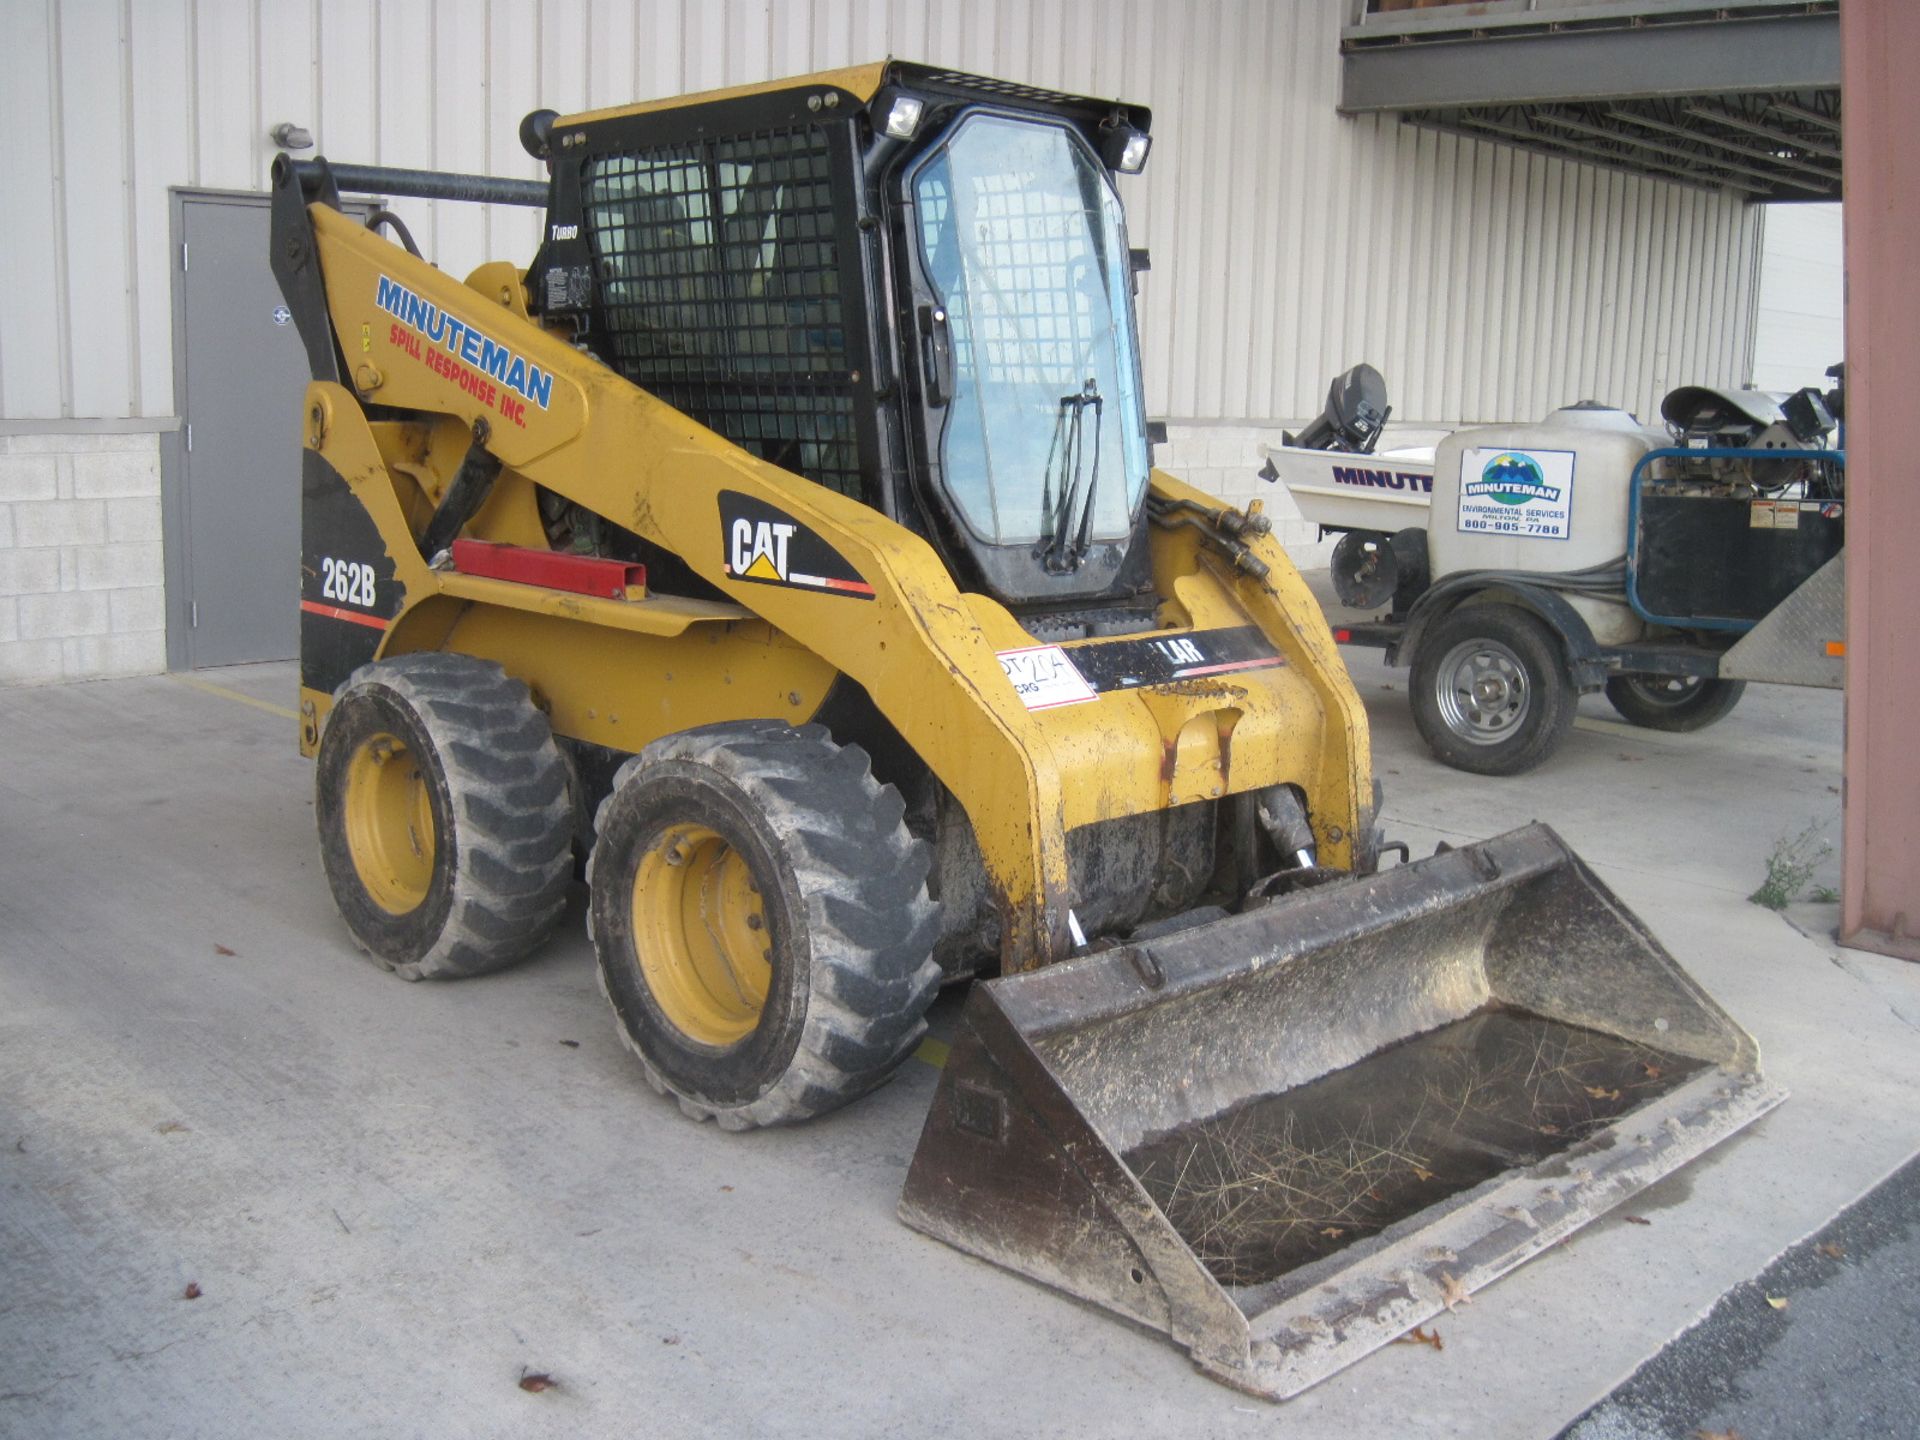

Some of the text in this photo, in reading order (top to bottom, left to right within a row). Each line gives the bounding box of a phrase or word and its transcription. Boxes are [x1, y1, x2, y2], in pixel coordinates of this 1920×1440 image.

[552, 225, 578, 240] TURBO
[375, 274, 554, 411] MINUTEMAN
[390, 323, 526, 429] SPILL RESPONSE INC.
[1467, 482, 1558, 501] MINUTEMAN
[1463, 505, 1565, 519] ENVIRONMENTAL SERVICES
[1464, 519, 1560, 534] 800-905-7788
[732, 518, 793, 582] CAT
[322, 557, 376, 607] 262B
